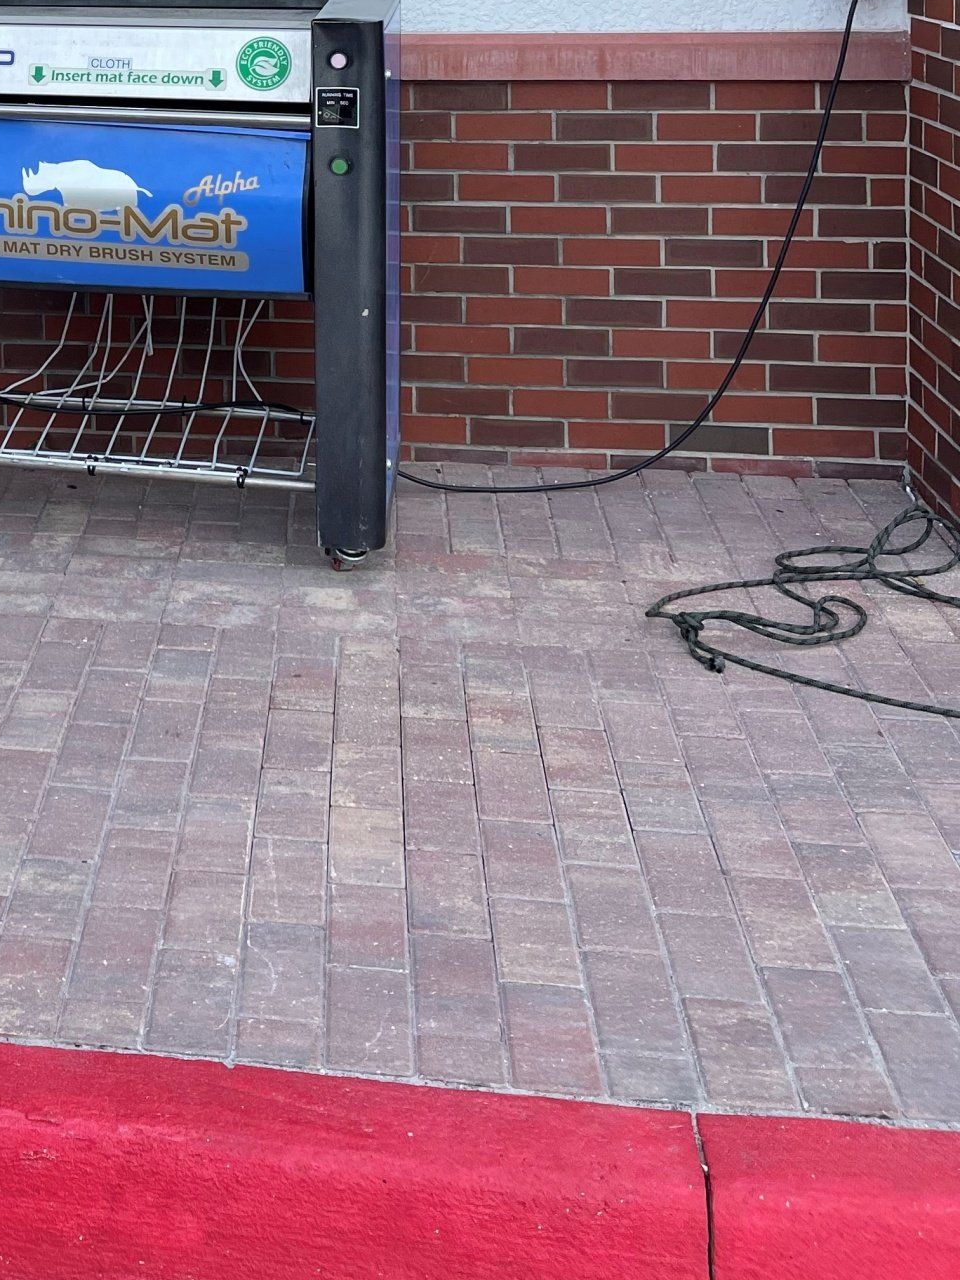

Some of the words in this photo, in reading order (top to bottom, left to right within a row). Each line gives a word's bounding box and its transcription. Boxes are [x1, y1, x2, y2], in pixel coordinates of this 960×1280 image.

[240, 48, 252, 65] ECO
[253, 40, 288, 66] FRIENDLY
[90, 58, 131, 70] CLOTH
[51, 70, 92, 83] Insert
[95, 73, 124, 84] mat
[127, 71, 158, 84] face
[161, 72, 204, 85] down
[246, 74, 281, 87] SYSTEM
[182, 170, 260, 207] Alpha
[3, 240, 40, 255] MAT
[46, 243, 83, 258] DRY
[89, 246, 153, 262] BRUSH
[159, 250, 236, 267] SYSTEM
